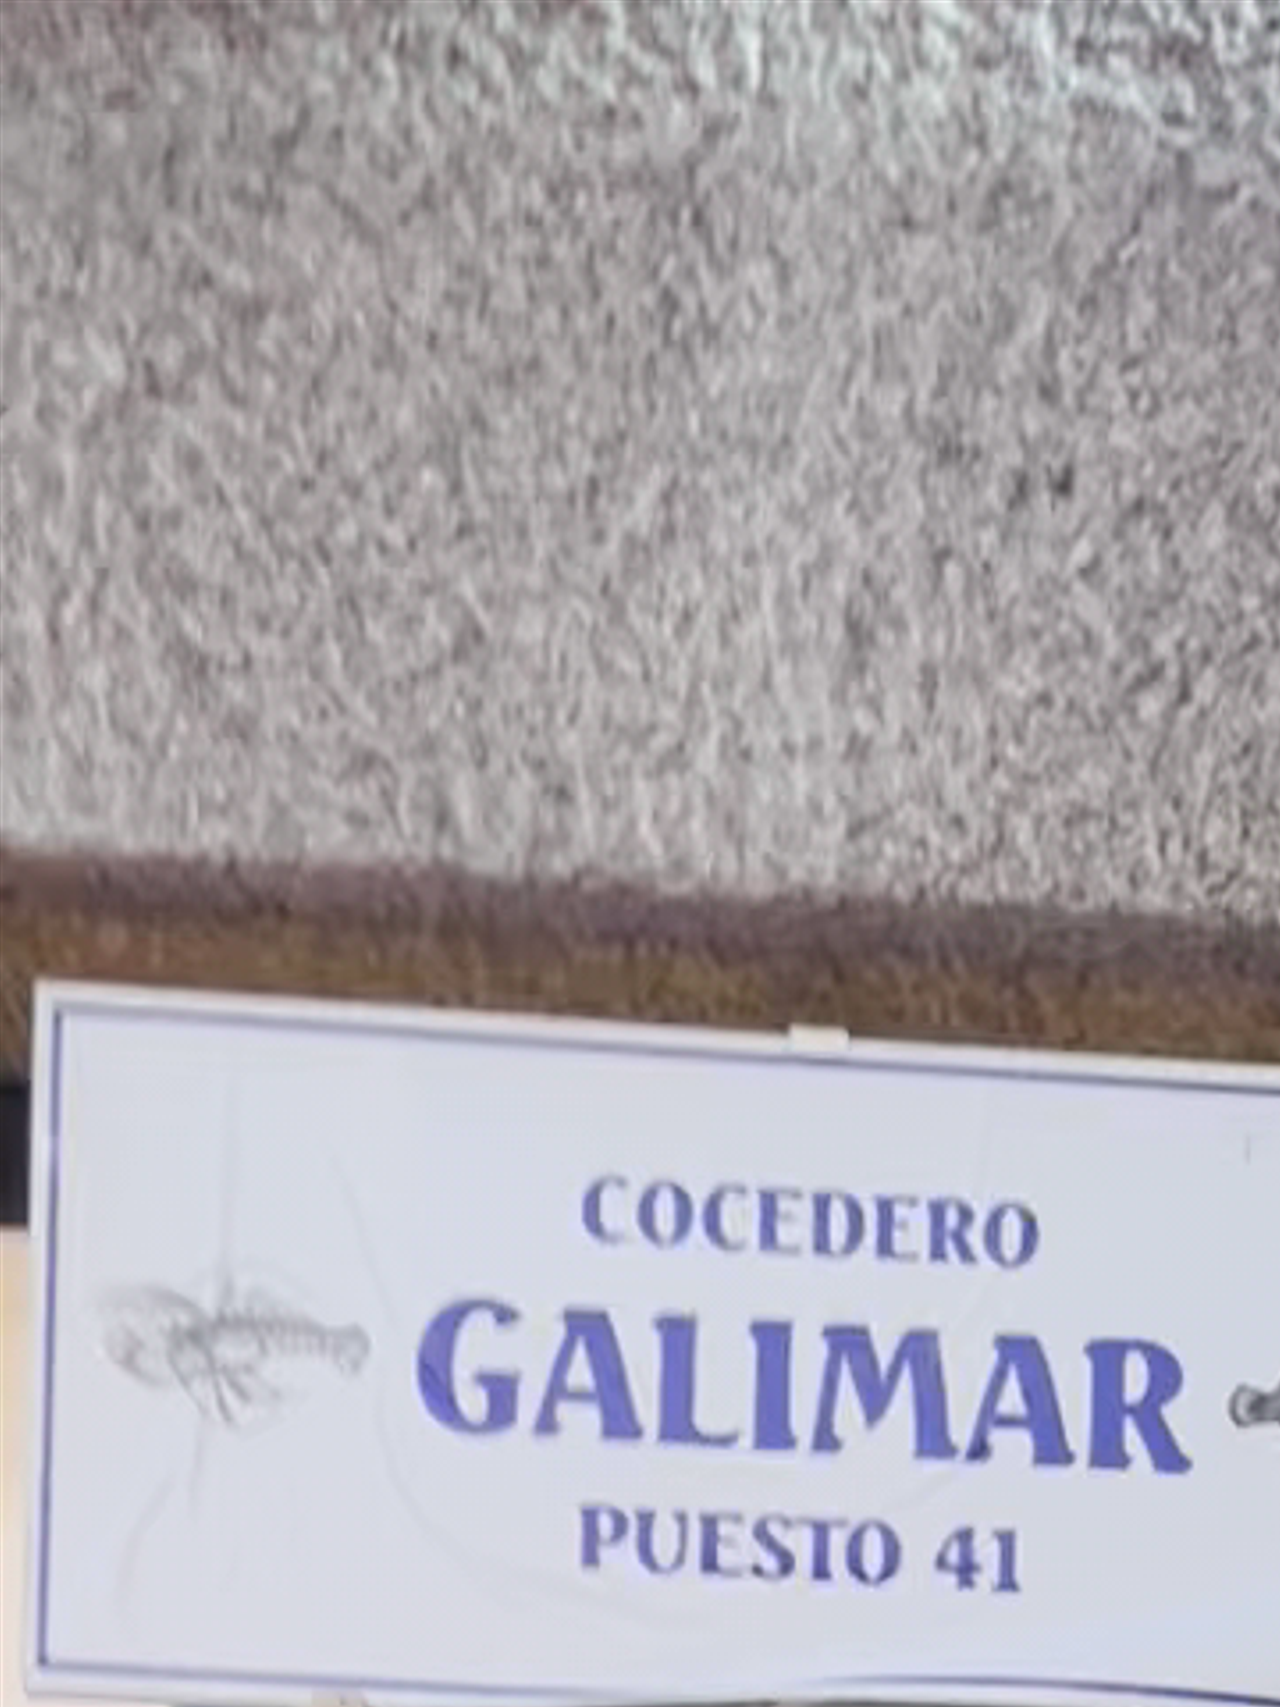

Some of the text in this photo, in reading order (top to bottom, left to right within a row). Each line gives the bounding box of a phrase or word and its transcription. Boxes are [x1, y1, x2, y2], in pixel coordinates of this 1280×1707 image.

[580, 1173, 1041, 1270] COCEDERO
[415, 1296, 1194, 1475] GALIMAR
[578, 1502, 1021, 1594] PUESTO 41
